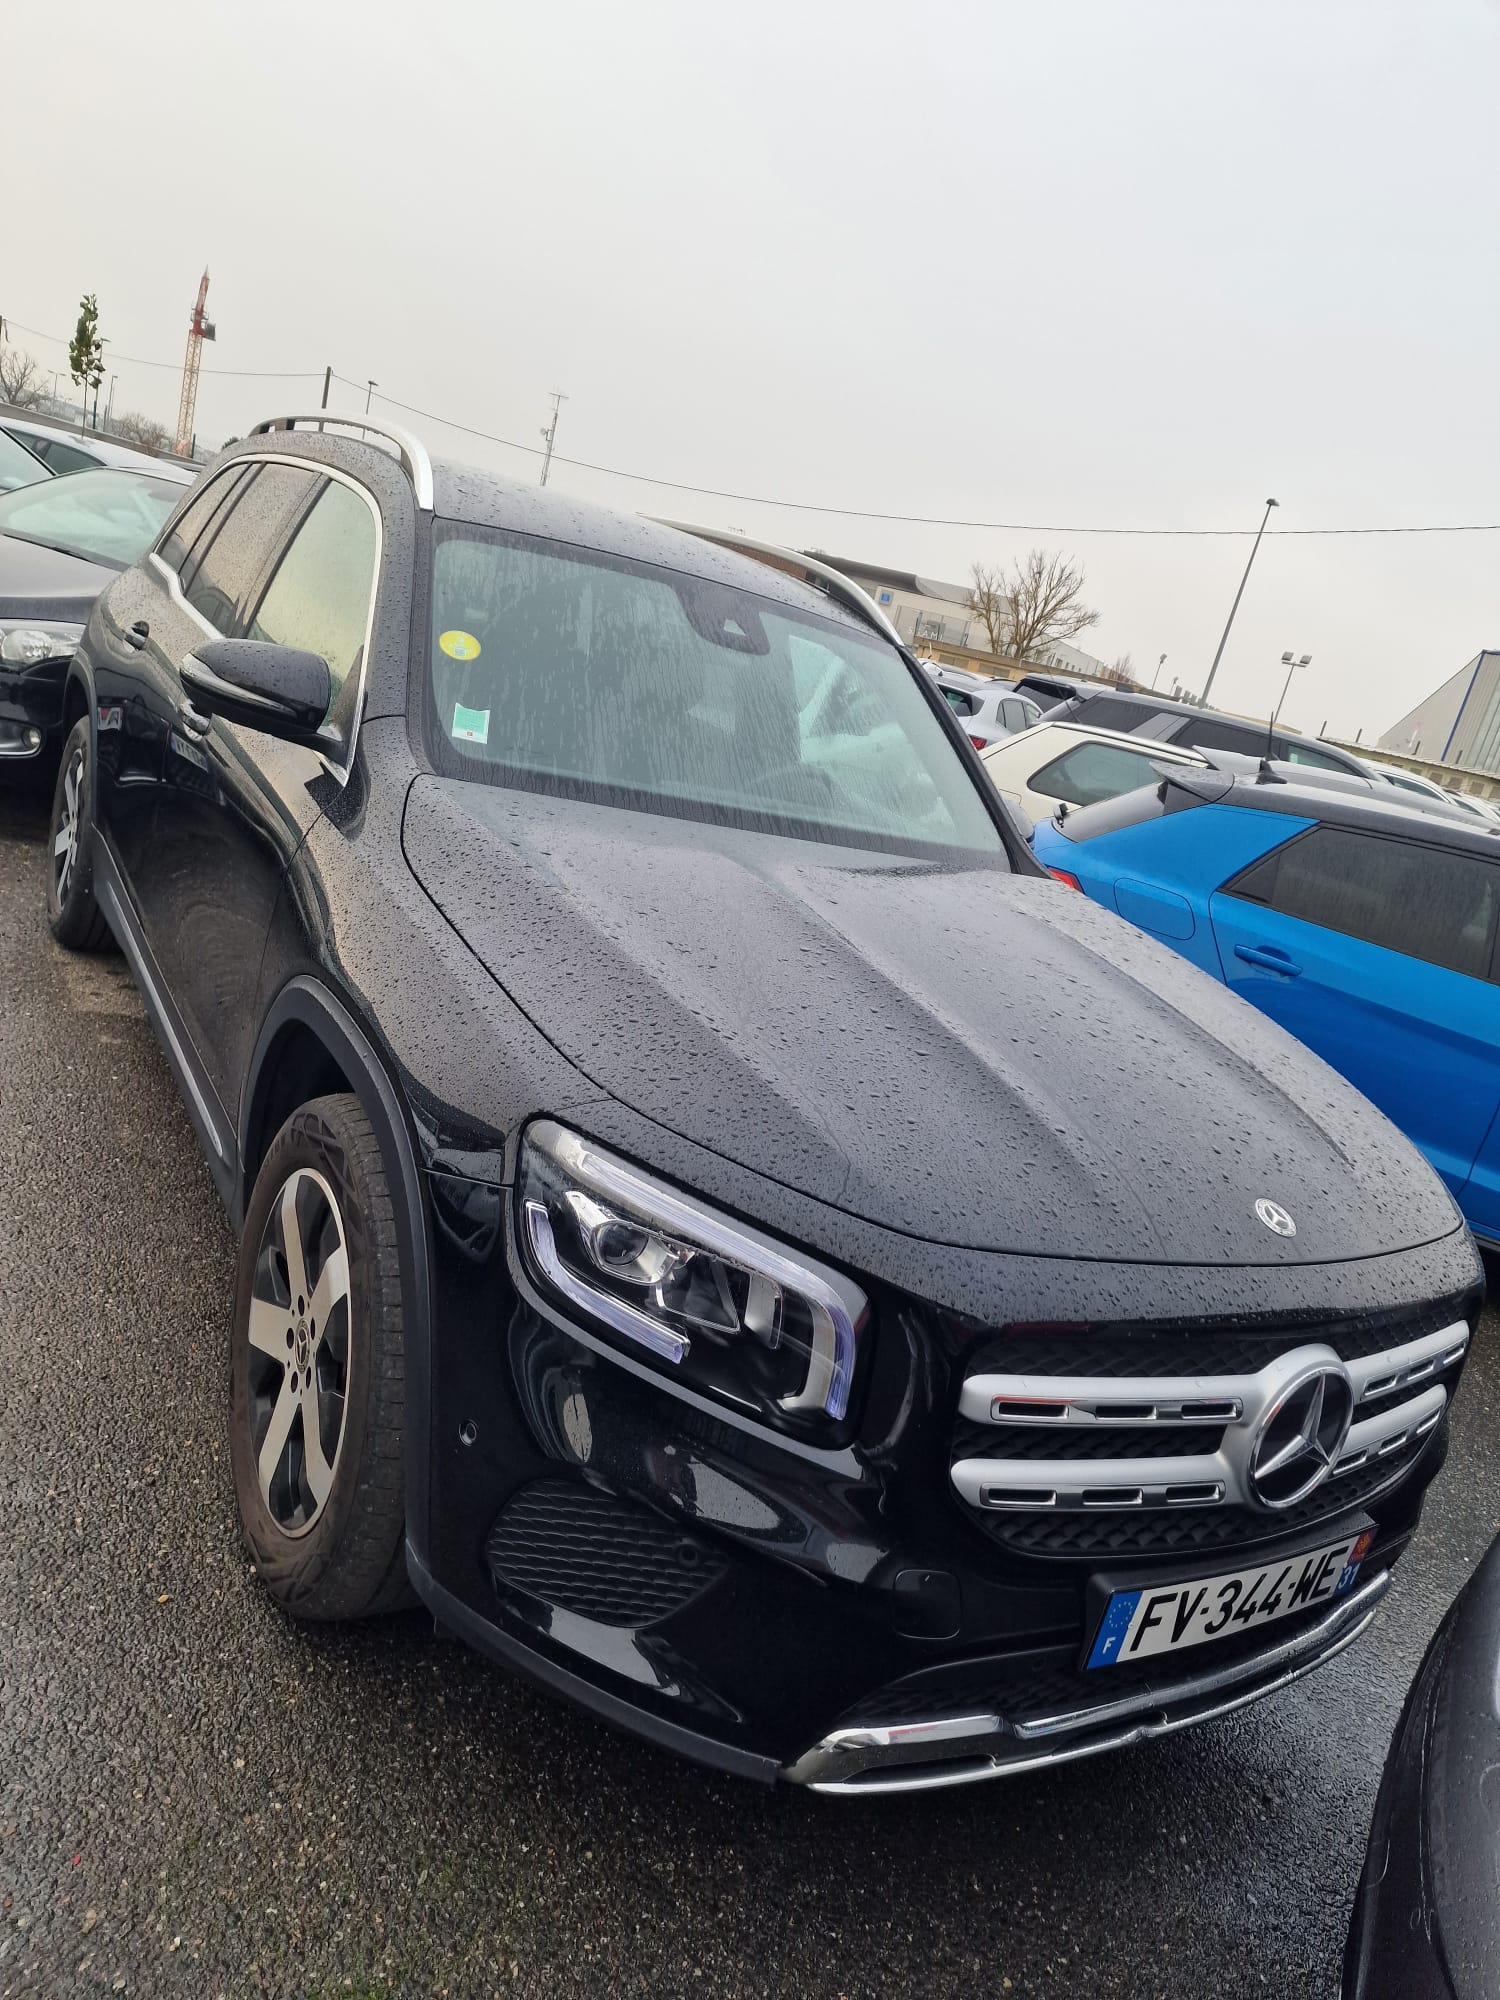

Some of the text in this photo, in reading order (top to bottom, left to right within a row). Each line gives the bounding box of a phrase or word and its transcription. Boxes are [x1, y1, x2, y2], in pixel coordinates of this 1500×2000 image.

[1338, 1562, 1360, 1589] 31
[1129, 1545, 1349, 1652] FV-344-WE
[1102, 1636, 1116, 1654] F
